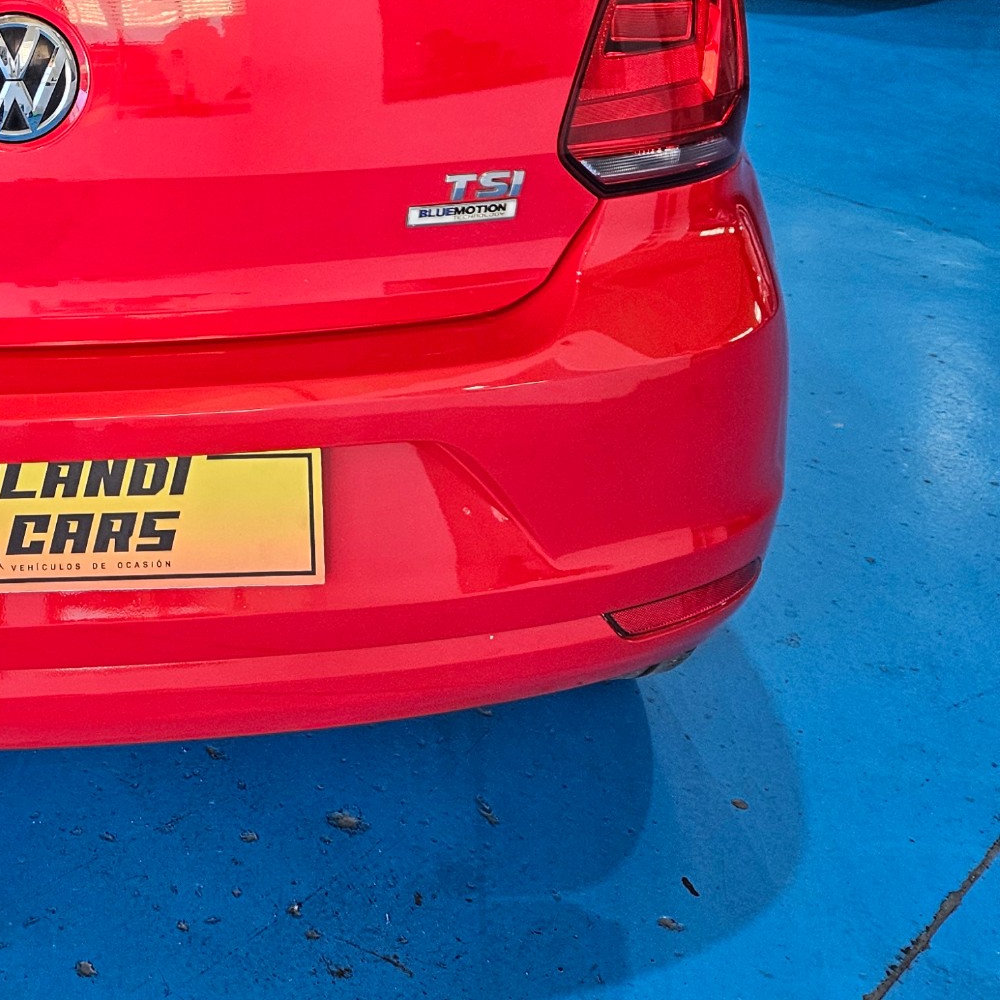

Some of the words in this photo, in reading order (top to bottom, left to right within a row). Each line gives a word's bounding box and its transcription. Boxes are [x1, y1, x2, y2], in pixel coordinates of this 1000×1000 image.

[445, 170, 525, 201] TSI
[418, 202, 507, 219] BLUEMOTION
[6, 511, 181, 555] CARS
[10, 562, 81, 572] VEHÍCULOS
[92, 562, 107, 570] DE
[117, 560, 172, 569] OCASIÓN
